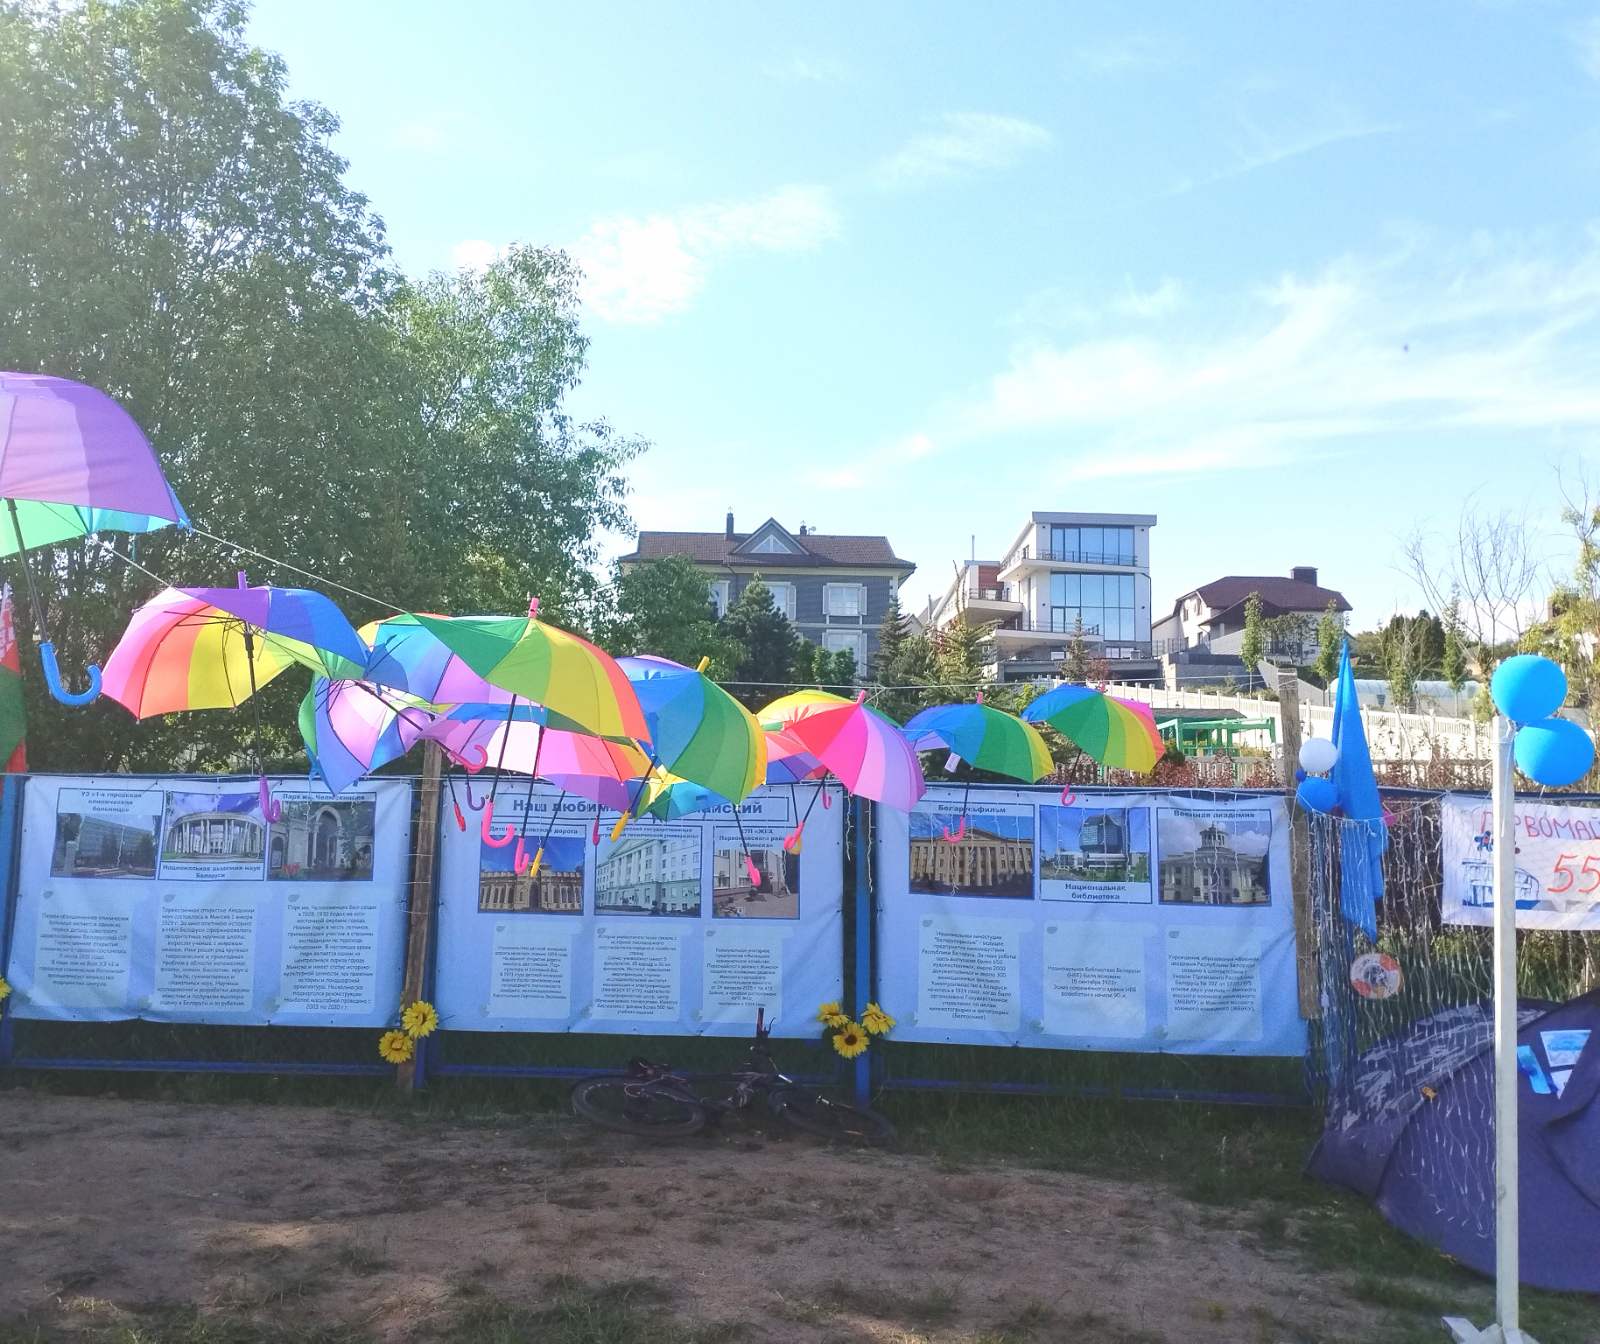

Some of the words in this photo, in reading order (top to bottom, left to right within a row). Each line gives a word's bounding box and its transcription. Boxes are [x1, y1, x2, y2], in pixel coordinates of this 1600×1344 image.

[513, 799, 547, 812] Наш
[1064, 883, 1127, 892] Национальная
[1071, 893, 1120, 901] библиотека
